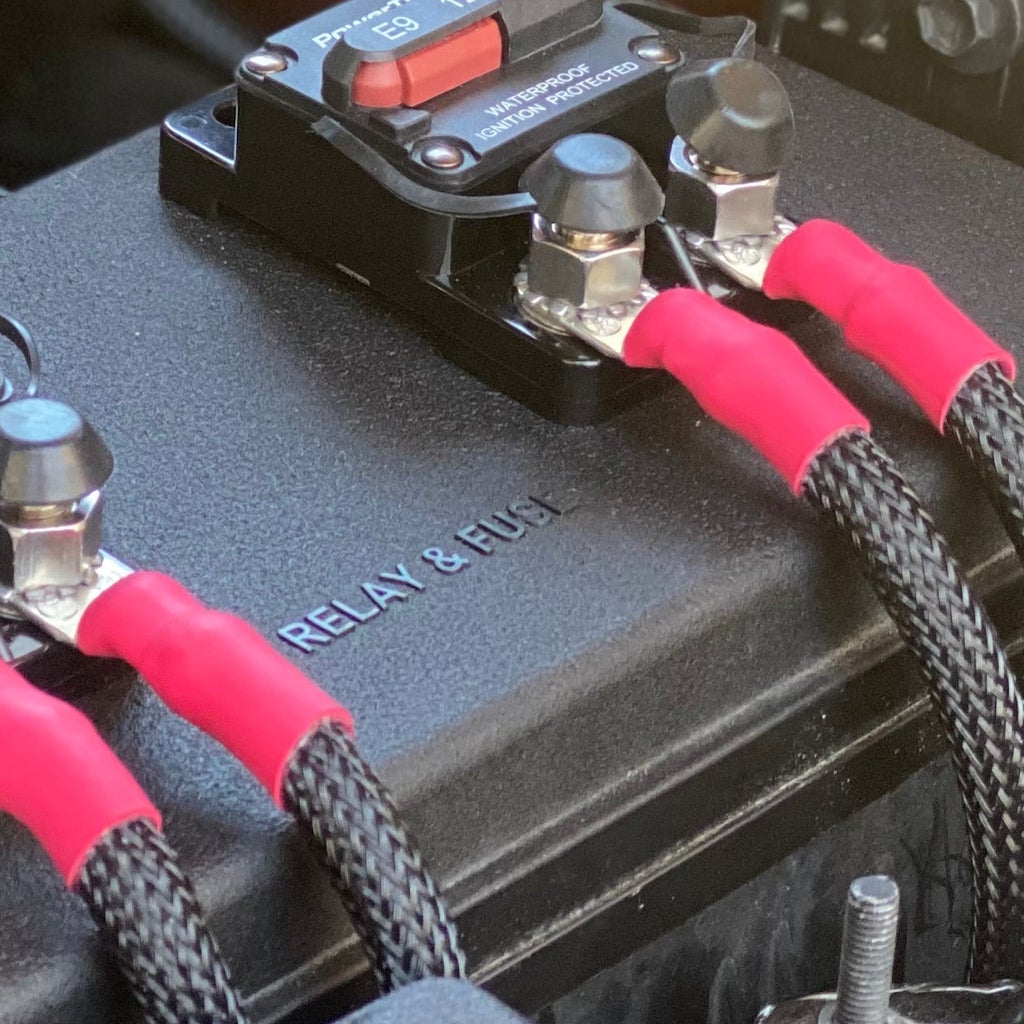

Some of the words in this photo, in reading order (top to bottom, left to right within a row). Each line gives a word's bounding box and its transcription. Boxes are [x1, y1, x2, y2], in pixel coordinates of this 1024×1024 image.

[371, 16, 420, 41] E9
[475, 103, 547, 141] IGNITION
[545, 61, 639, 106] PROTECTED
[484, 63, 590, 117] WATERPROOF
[277, 563, 425, 653] RELAY
[422, 546, 470, 574] &
